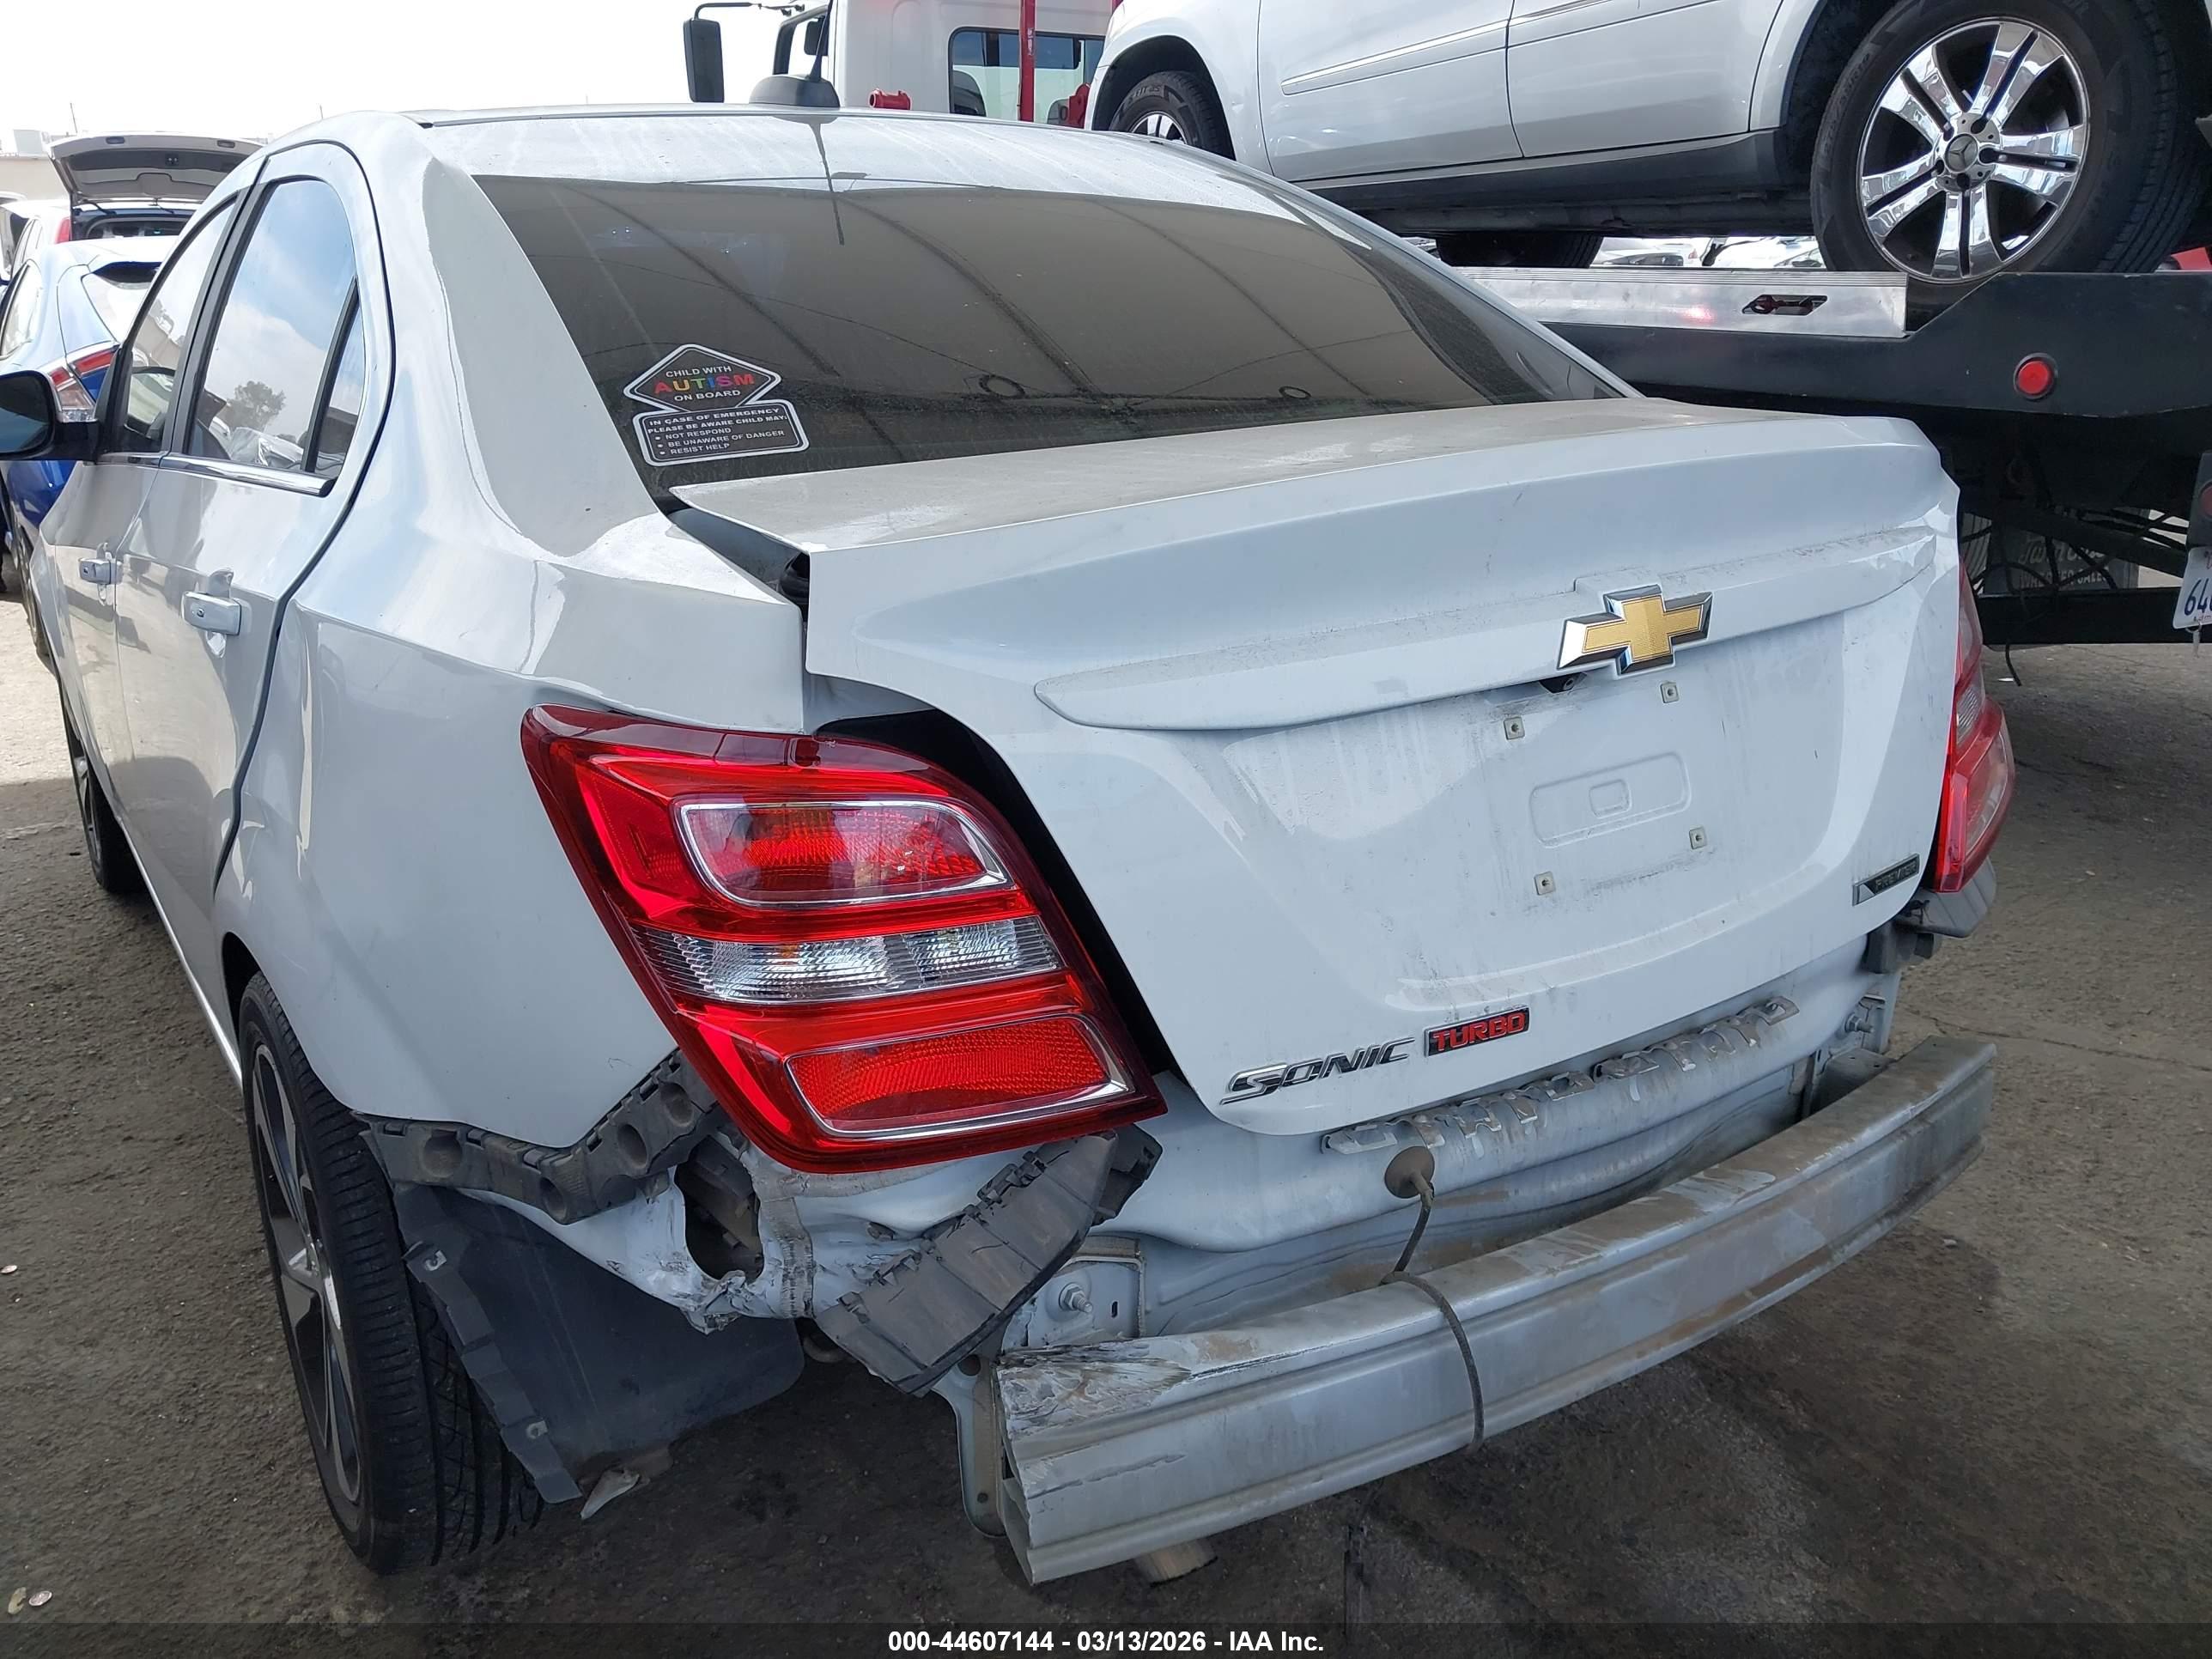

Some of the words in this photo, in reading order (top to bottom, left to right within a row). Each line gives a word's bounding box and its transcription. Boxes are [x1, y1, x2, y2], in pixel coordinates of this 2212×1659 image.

[665, 368, 700, 378] CHILD
[702, 365, 732, 374] WITH
[654, 374, 755, 394] AUTISM
[696, 389, 741, 400] BOARD
[664, 416, 694, 424] CASE
[713, 408, 780, 419] EMERGENCY
[647, 425, 684, 434] PLEASE
[701, 419, 734, 428] AWARE
[686, 428, 732, 437] RESPOND
[683, 435, 730, 446] UNAWARE
[745, 430, 785, 439] DANGER
[670, 446, 703, 454] RESIST
[2184, 578, 2212, 616] 64
[1219, 1037, 1415, 1106] SONIC
[1431, 1012, 1526, 1053] TURBO
